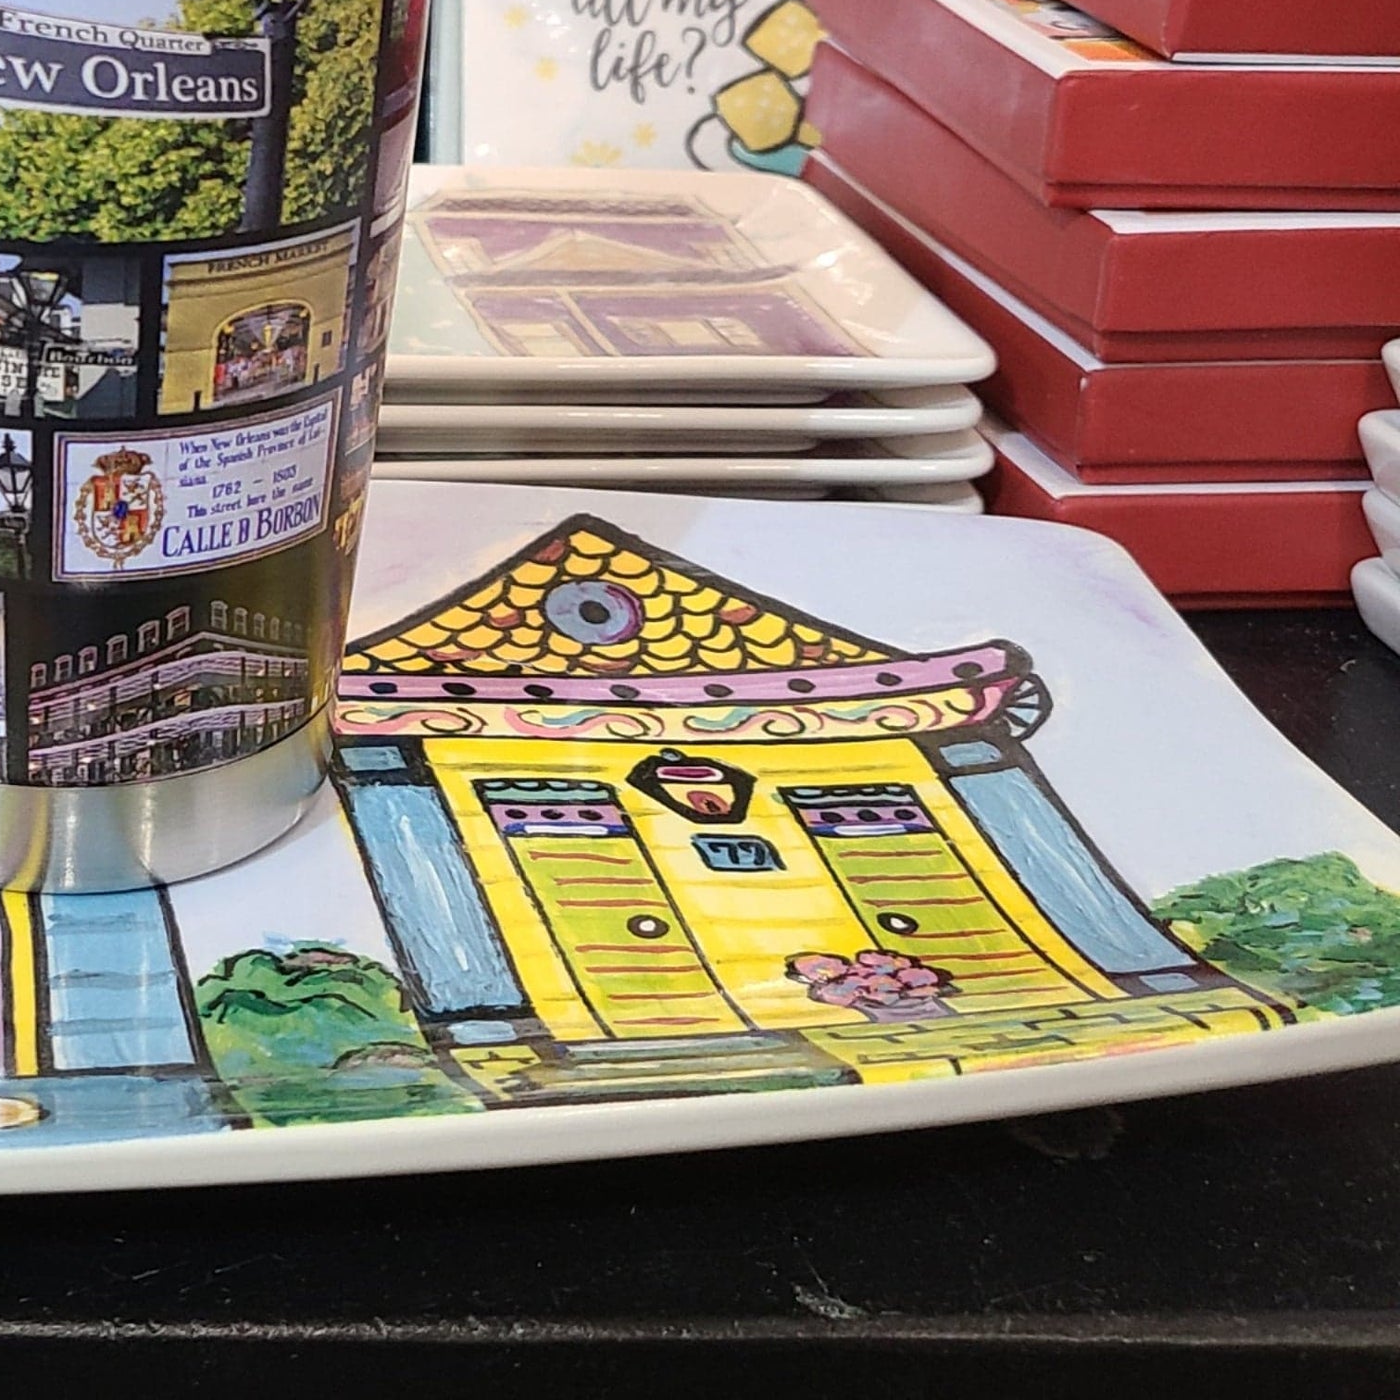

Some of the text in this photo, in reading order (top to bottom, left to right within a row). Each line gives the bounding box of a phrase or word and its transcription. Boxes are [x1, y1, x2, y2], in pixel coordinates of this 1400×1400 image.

[118, 29, 205, 53] Quarter
[81, 54, 260, 104] Orleans
[588, 27, 706, 105] life?
[207, 242, 332, 275] FRENCH MARKET
[179, 441, 208, 455] When
[211, 438, 232, 451] New
[235, 431, 271, 446] Orleans
[179, 458, 188, 472] of
[194, 455, 211, 468] the
[217, 449, 253, 468] Spanish
[187, 505, 207, 519] This
[210, 500, 242, 515] street
[272, 486, 287, 499] the
[212, 481, 242, 499] 1762
[162, 520, 234, 558] CALLE
[253, 492, 320, 541] BORBON
[708, 841, 766, 866] 77
